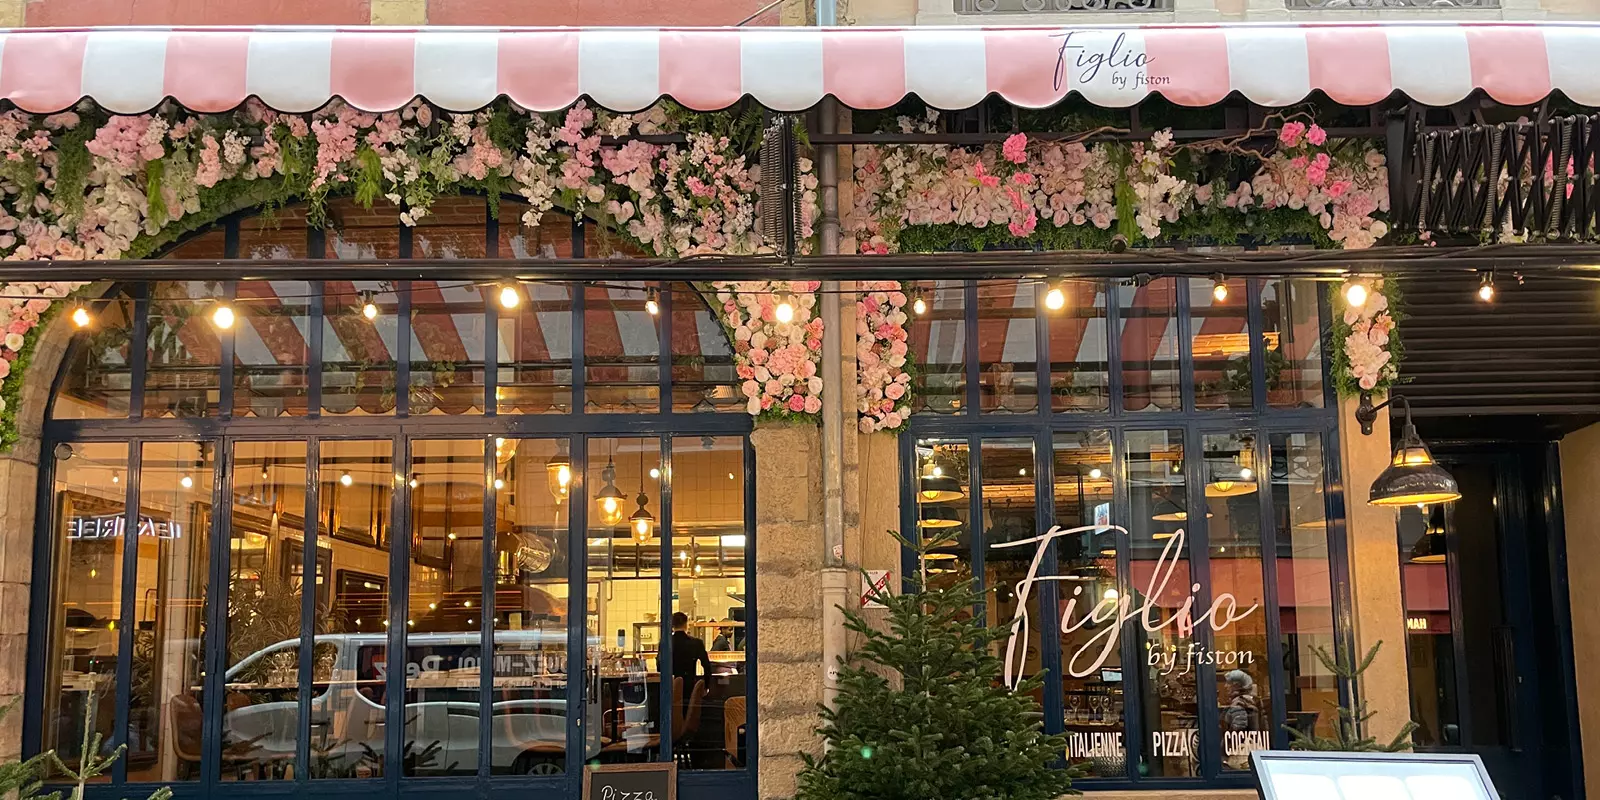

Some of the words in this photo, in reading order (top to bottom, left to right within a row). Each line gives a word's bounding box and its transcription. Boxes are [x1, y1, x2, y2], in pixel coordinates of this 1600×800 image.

[1048, 30, 1156, 92] Figlio
[1111, 71, 1128, 90] by
[1132, 71, 1170, 90] fiston
[990, 525, 1259, 692] Figlio
[1147, 643, 1177, 676] by
[1179, 642, 1255, 676] fiston
[1069, 731, 1124, 758] ITALIENNE
[1153, 731, 1190, 757] PIZZA
